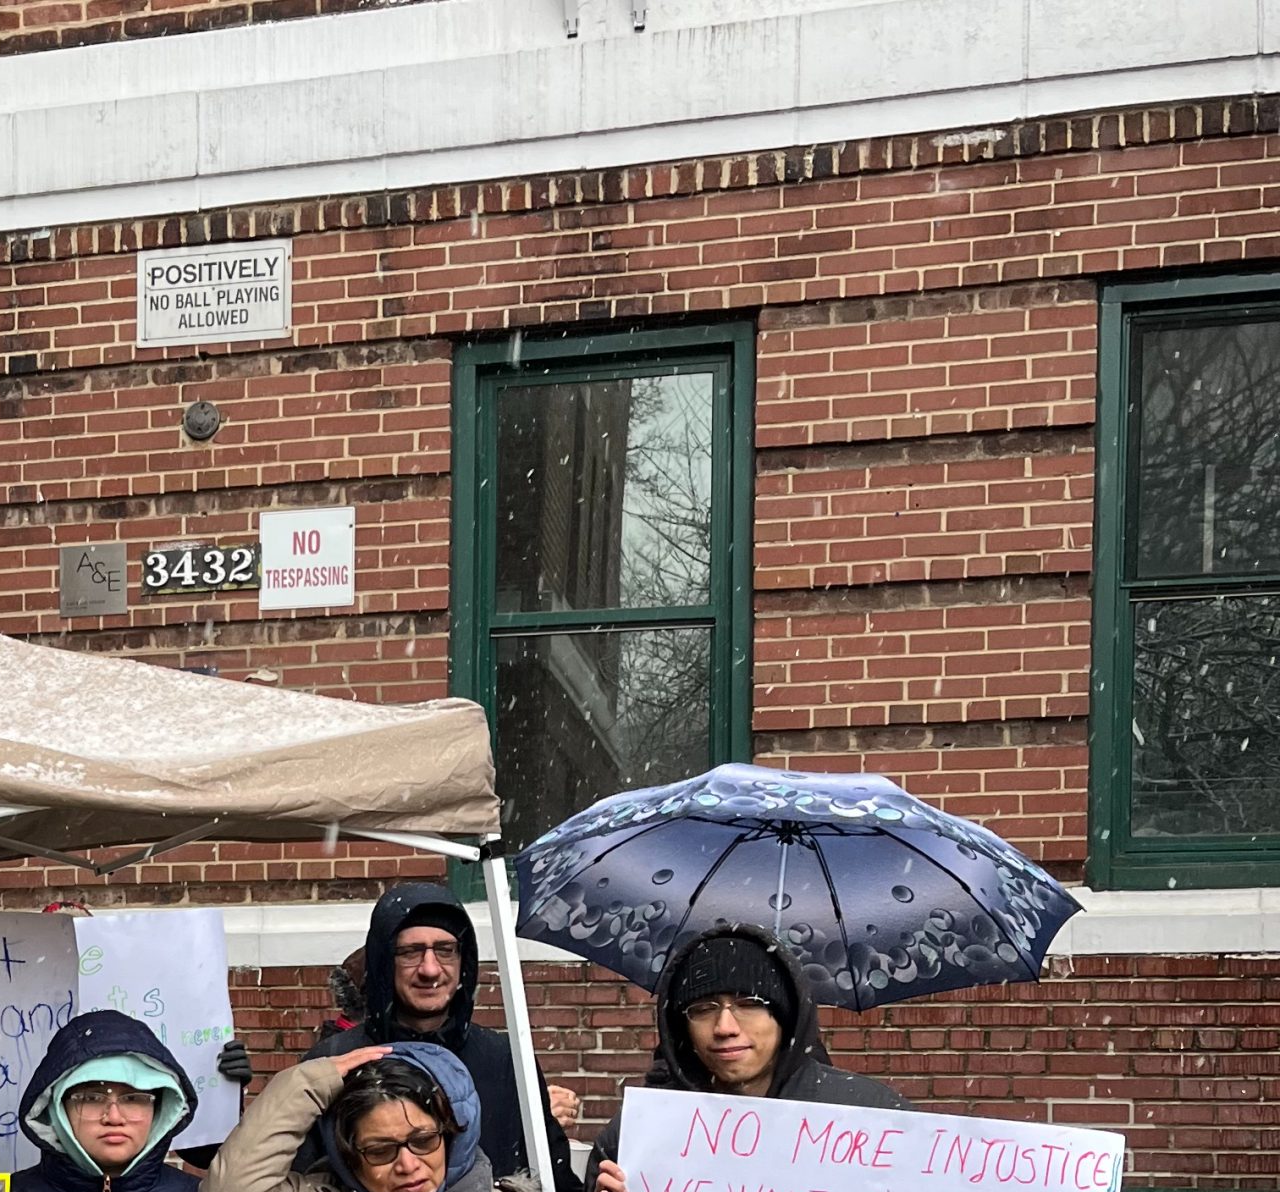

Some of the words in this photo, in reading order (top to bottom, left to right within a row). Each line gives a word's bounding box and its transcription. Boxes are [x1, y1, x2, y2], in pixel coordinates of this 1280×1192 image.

[150, 256, 280, 286] POSITIVELY
[149, 293, 169, 311] NO
[175, 290, 211, 310] BALL
[217, 285, 280, 305] PLAYING
[178, 308, 250, 330] ALLOWED
[292, 529, 321, 556] NO
[76, 552, 121, 593] A&E
[146, 548, 254, 588] 3432
[265, 565, 349, 590] TRESPASSING
[1, 990, 74, 1039] and
[680, 1107, 761, 1159] NO
[792, 1117, 905, 1169] MORE
